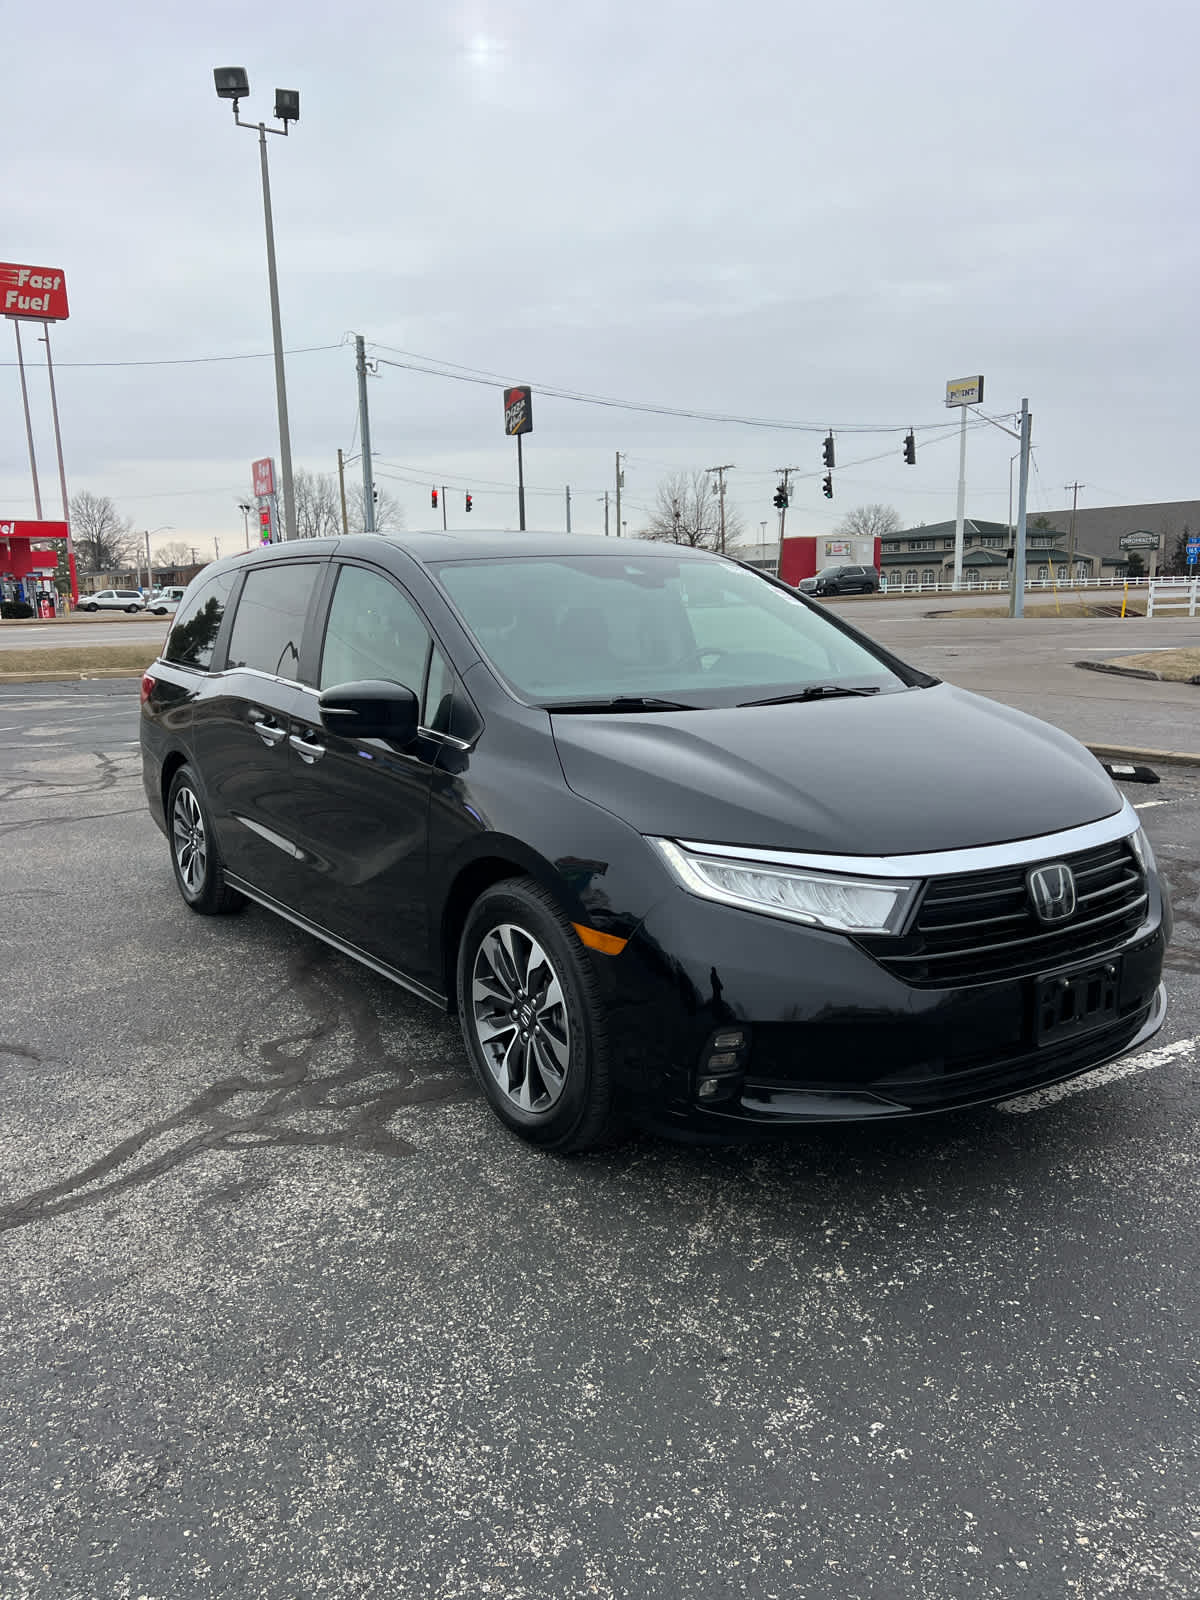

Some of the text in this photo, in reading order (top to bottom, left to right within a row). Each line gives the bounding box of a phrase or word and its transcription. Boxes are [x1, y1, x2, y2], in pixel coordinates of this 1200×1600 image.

[18, 269, 61, 290] Fast
[5, 290, 50, 311] Fuel
[505, 399, 526, 426] Pizza
[0, 522, 15, 534] el
